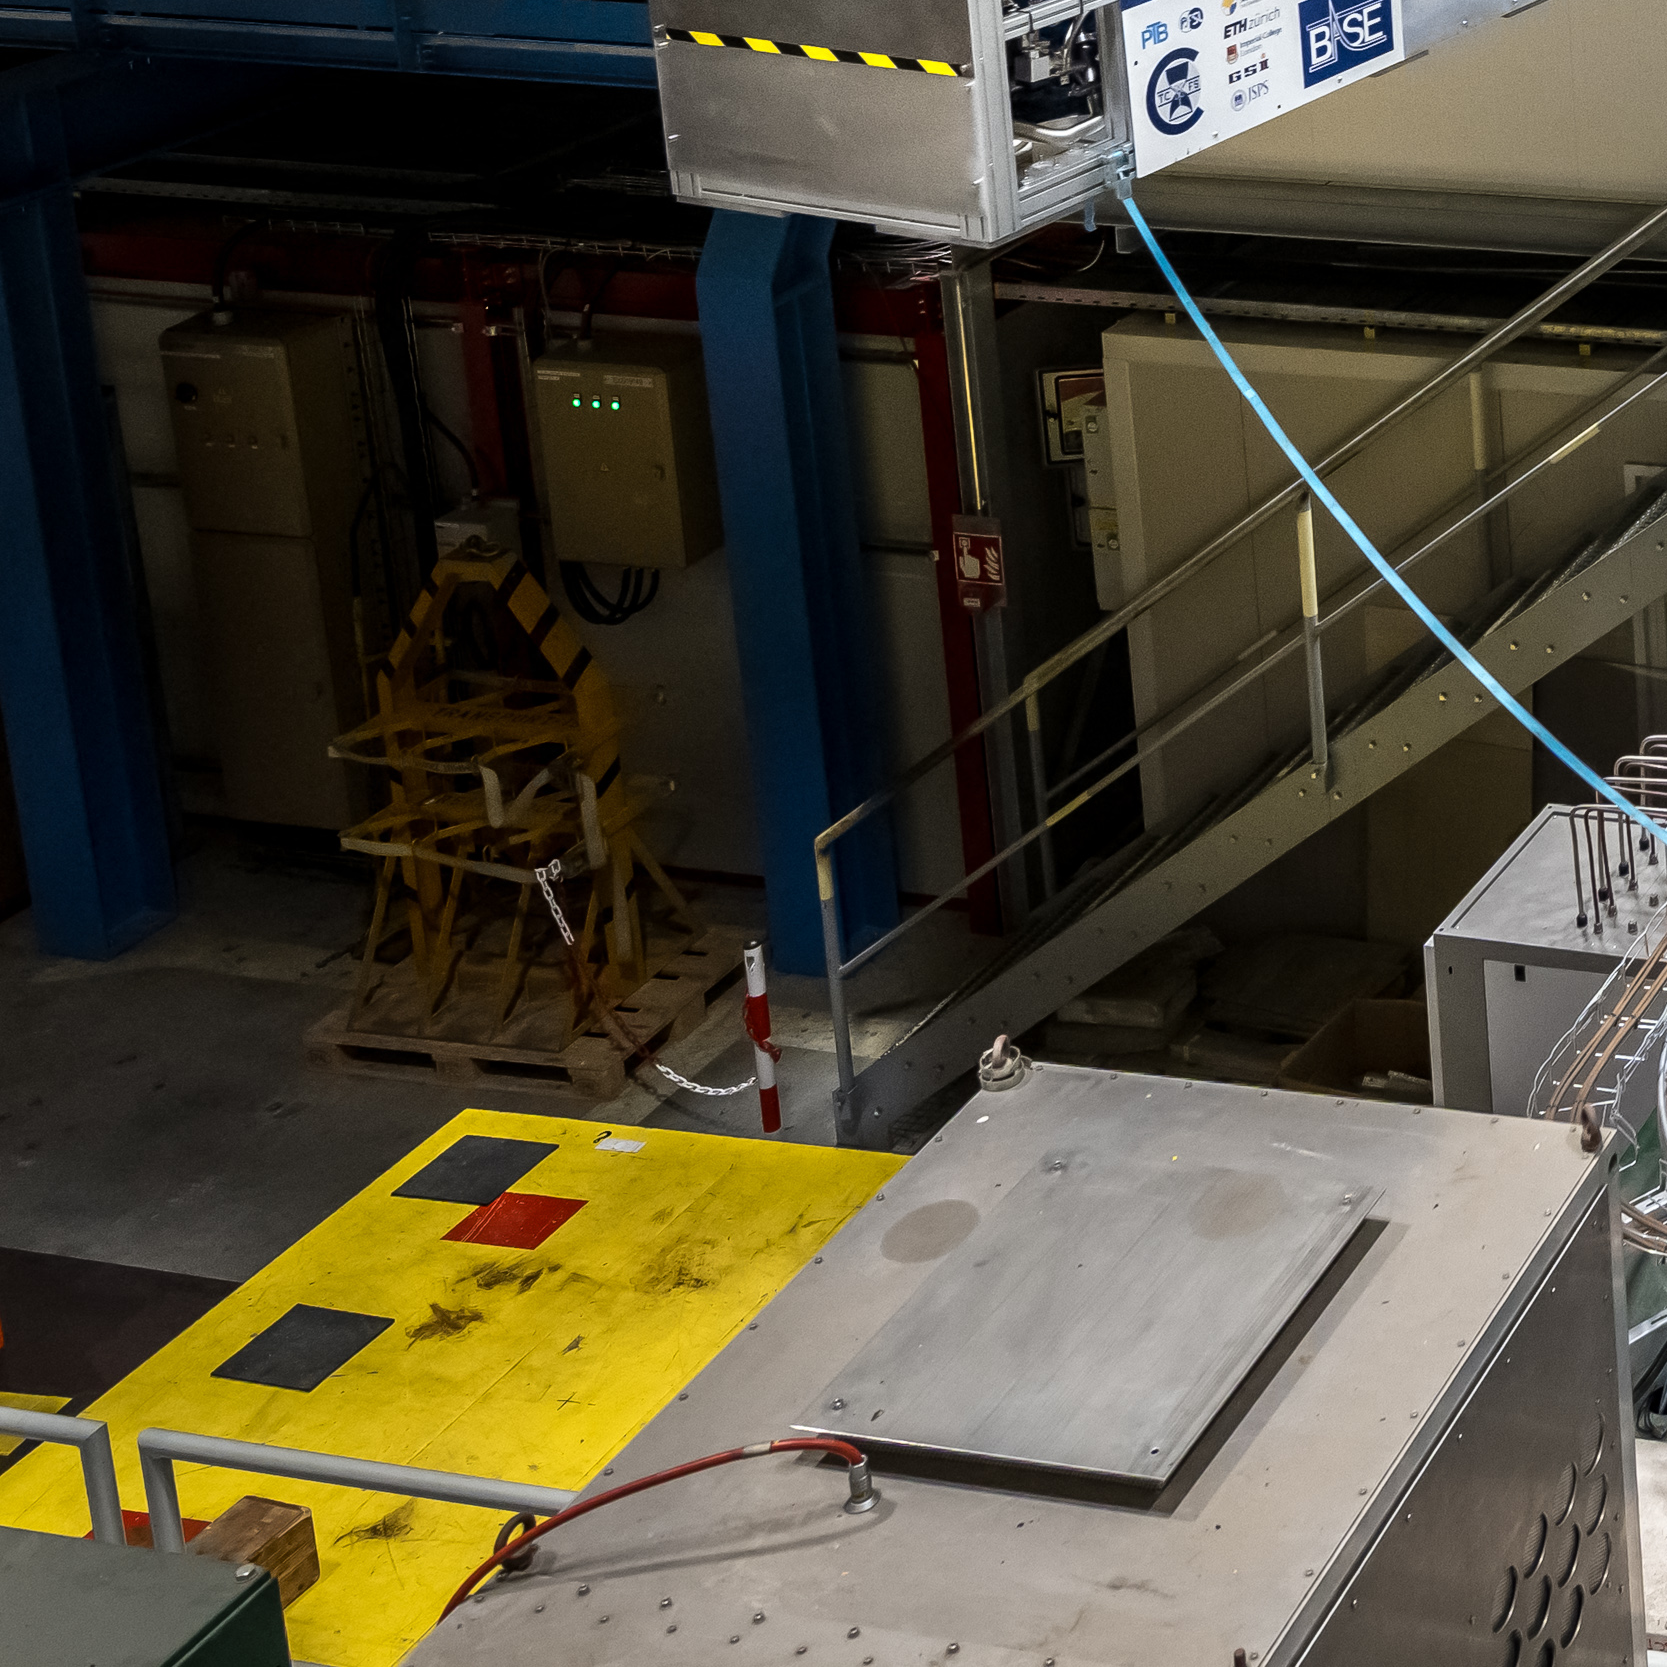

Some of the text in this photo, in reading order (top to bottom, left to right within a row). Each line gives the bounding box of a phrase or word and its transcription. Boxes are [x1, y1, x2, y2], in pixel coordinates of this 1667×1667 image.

[1224, 17, 1247, 40] ETH
[1248, 7, 1280, 30] zürich
[1248, 79, 1269, 104] JSPS
